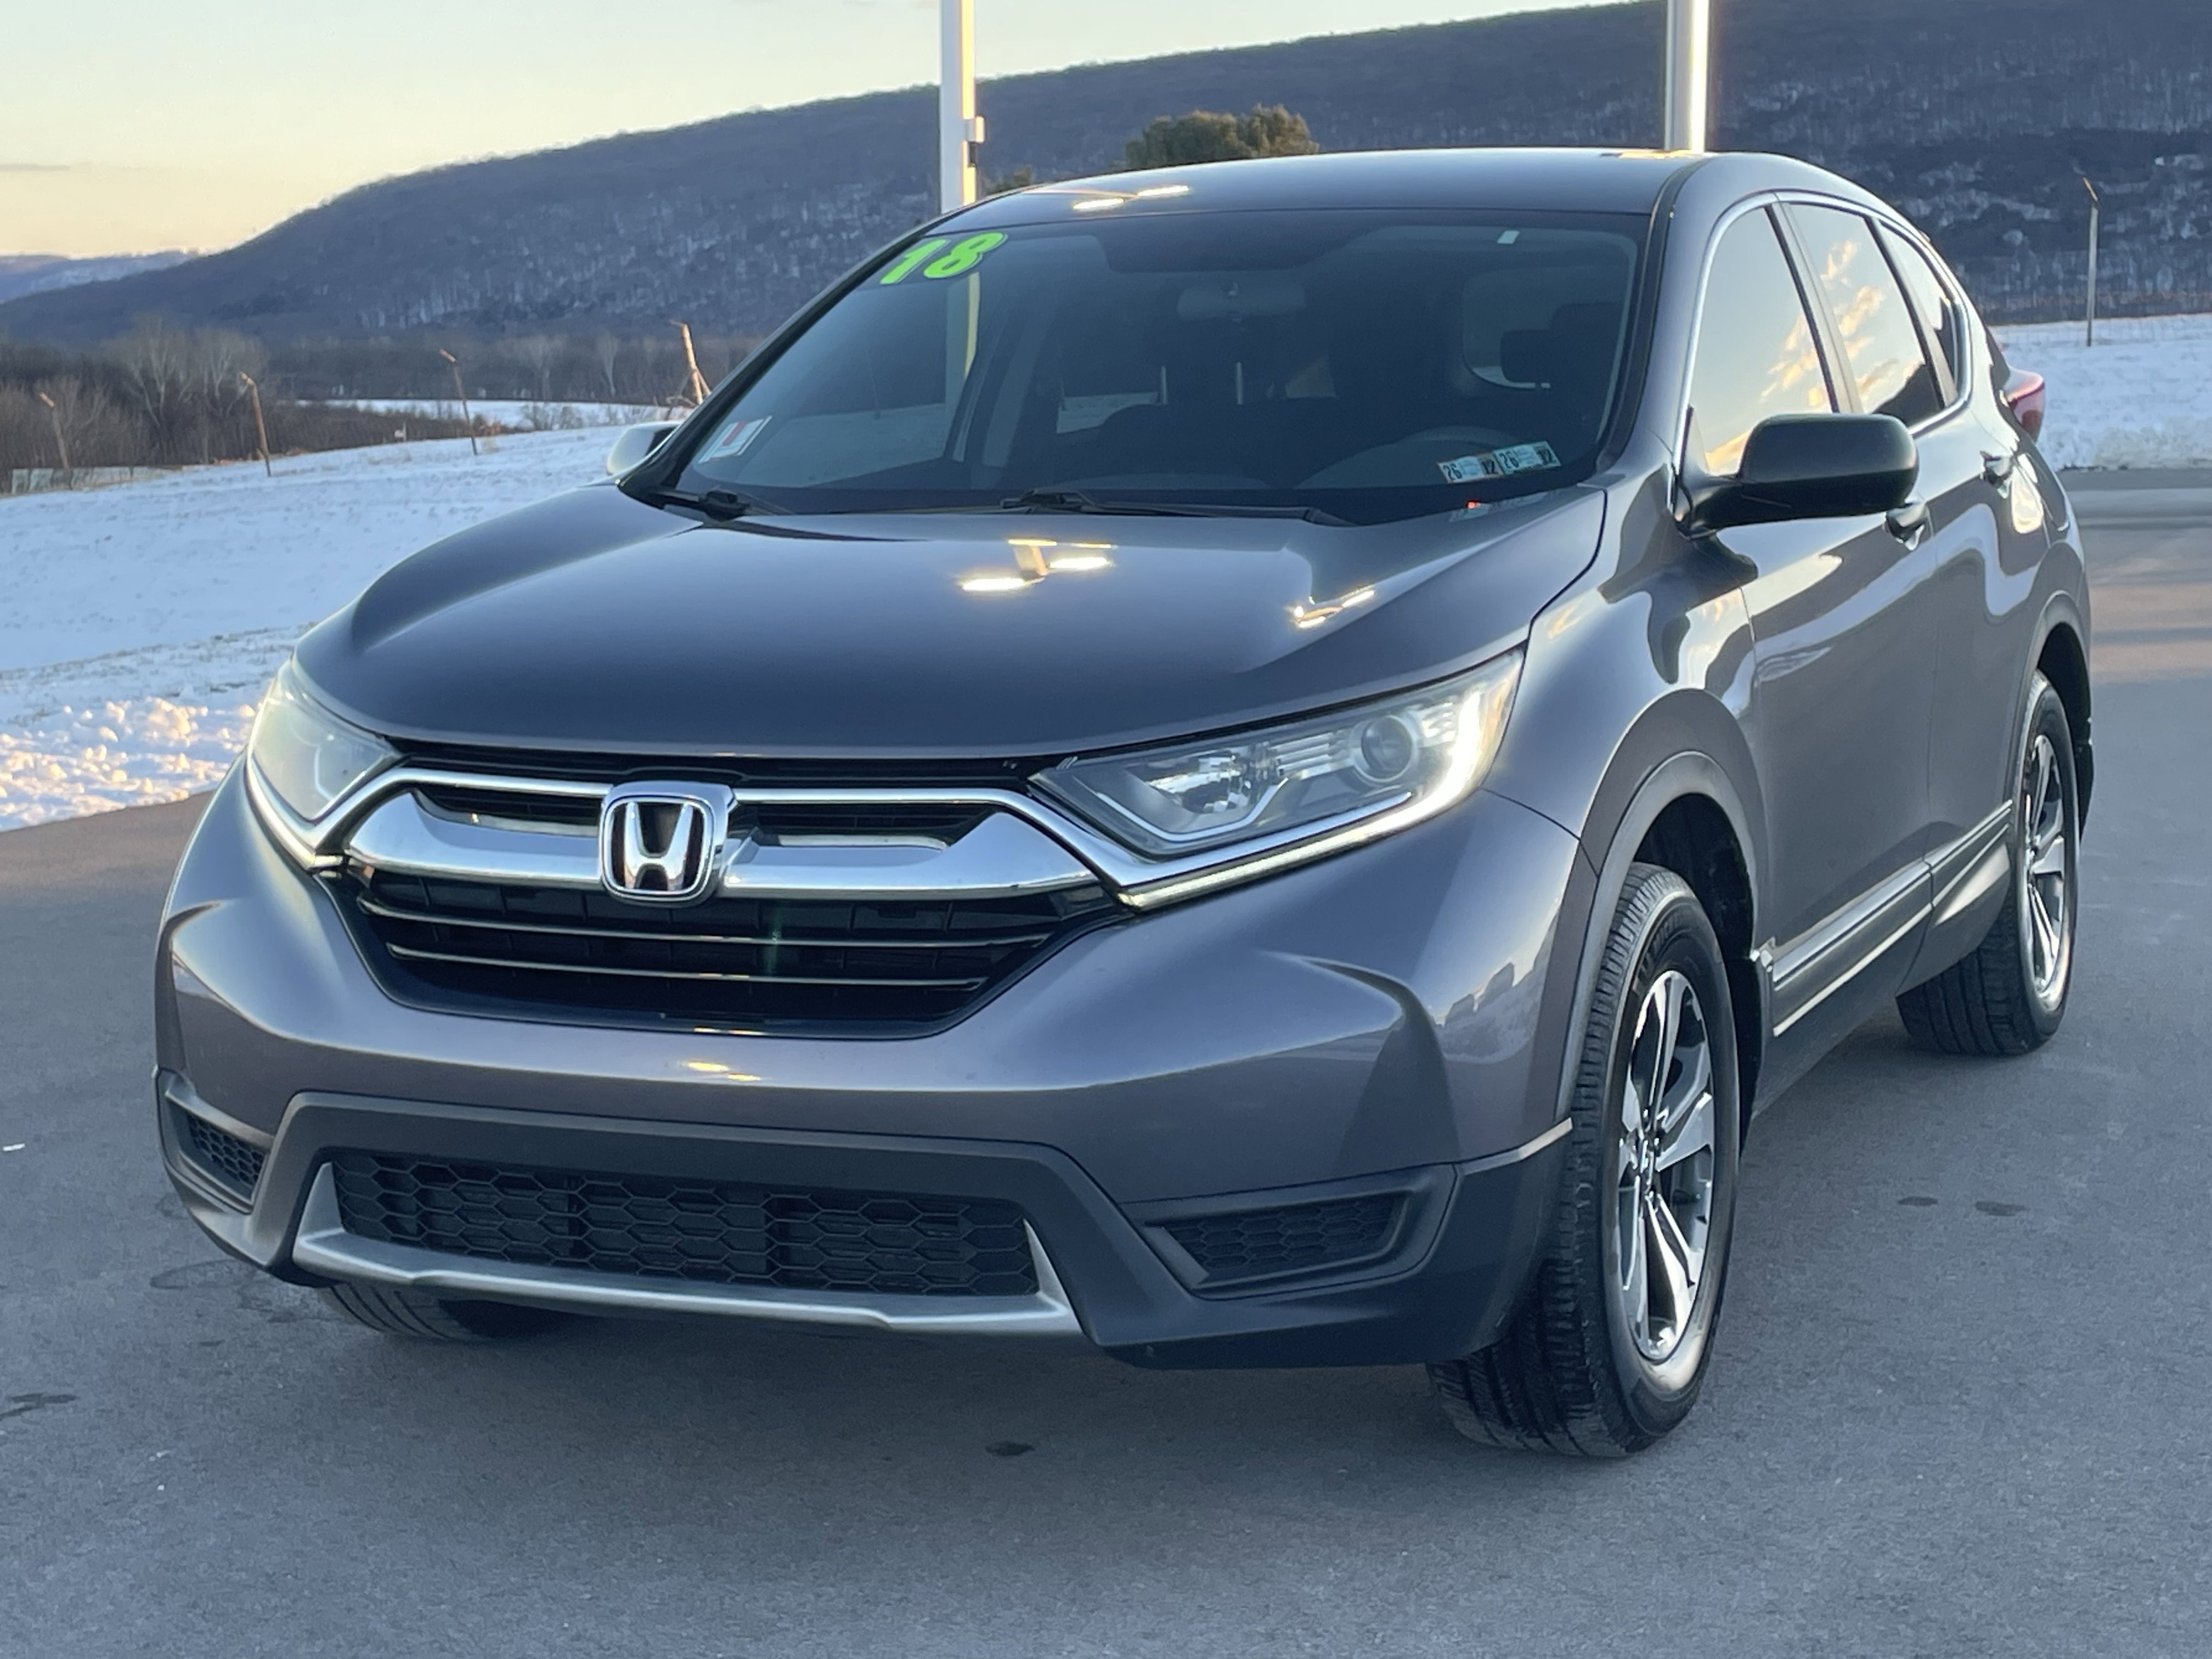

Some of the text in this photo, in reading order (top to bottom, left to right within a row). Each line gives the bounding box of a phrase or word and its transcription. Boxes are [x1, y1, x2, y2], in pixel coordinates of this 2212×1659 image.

[879, 232, 1008, 284] 18
[1443, 462, 1463, 481] 26
[1499, 450, 1520, 469] 26
[624, 801, 694, 891] H
